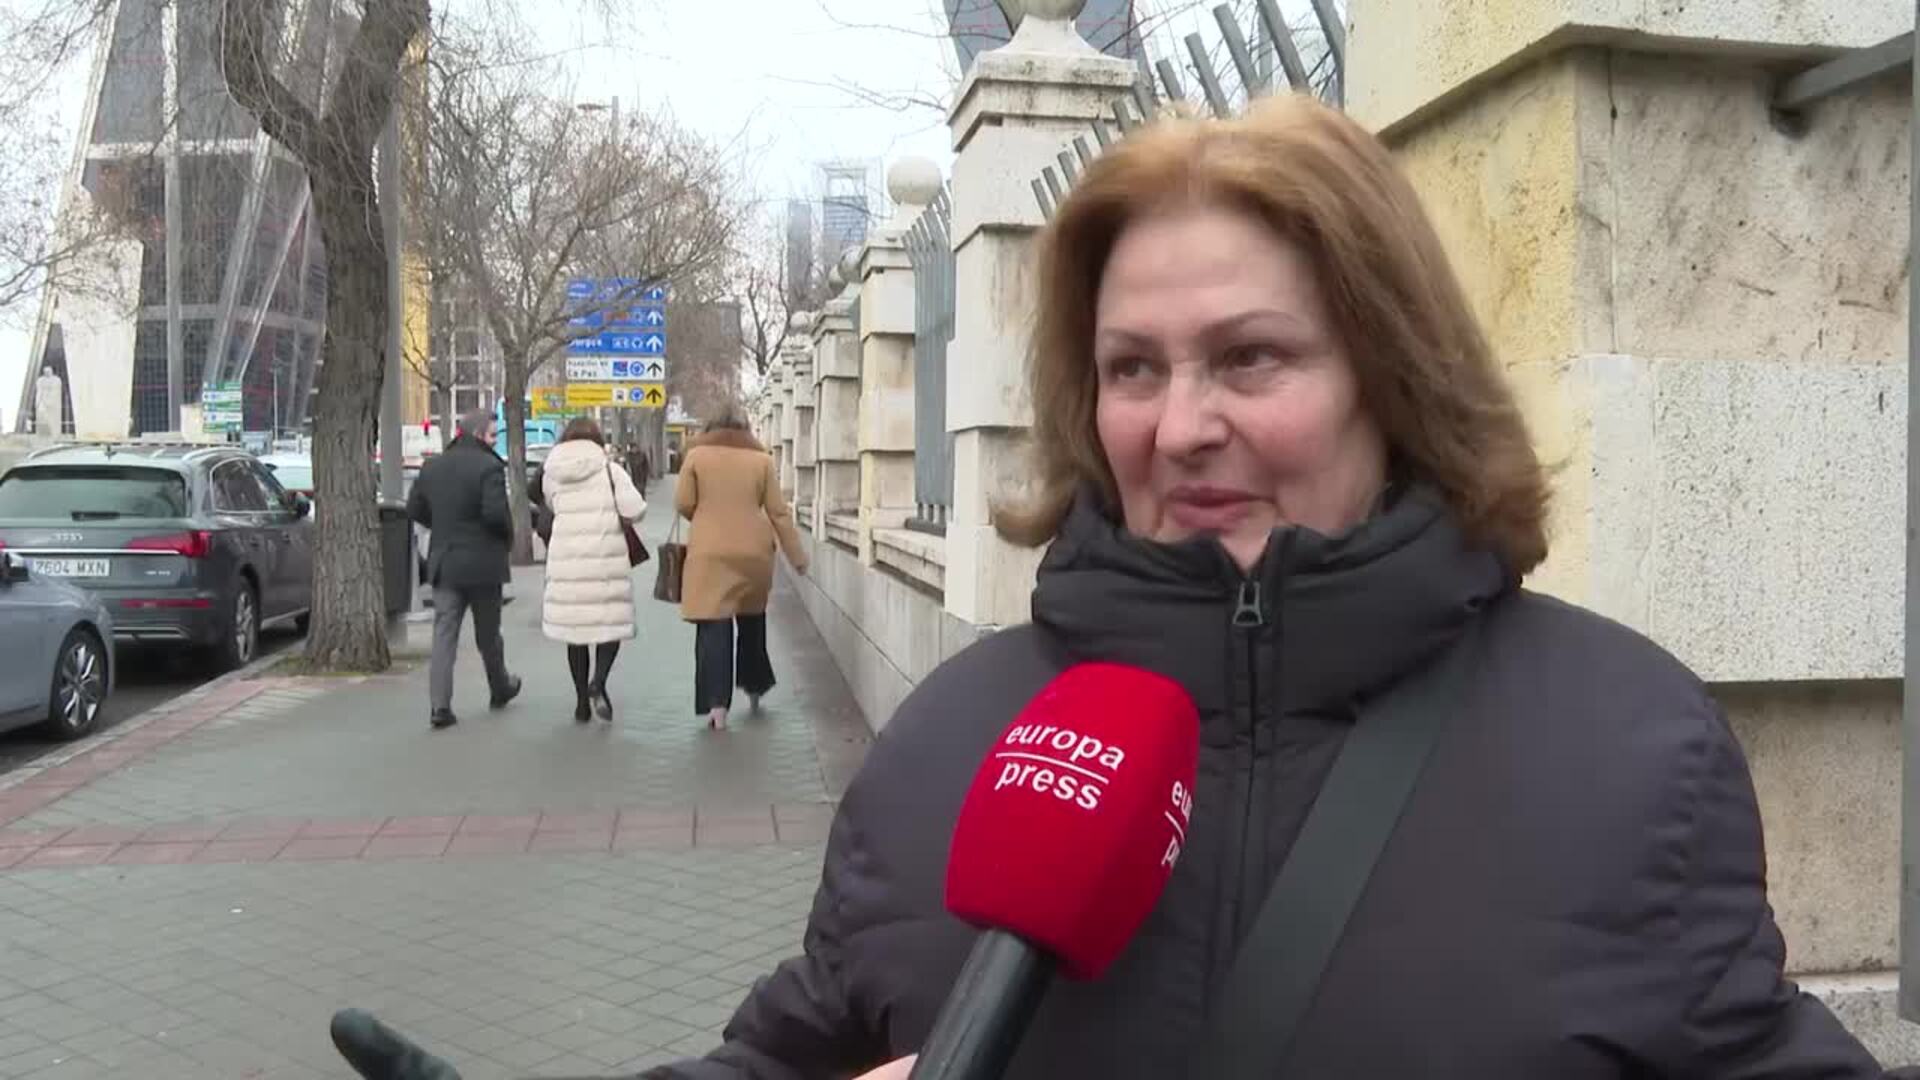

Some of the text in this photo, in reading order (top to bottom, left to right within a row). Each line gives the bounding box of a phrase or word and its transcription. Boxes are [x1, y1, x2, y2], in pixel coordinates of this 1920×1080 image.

[77, 560, 106, 575] MXN
[1006, 724, 1125, 771] europa
[994, 761, 1102, 810] press
